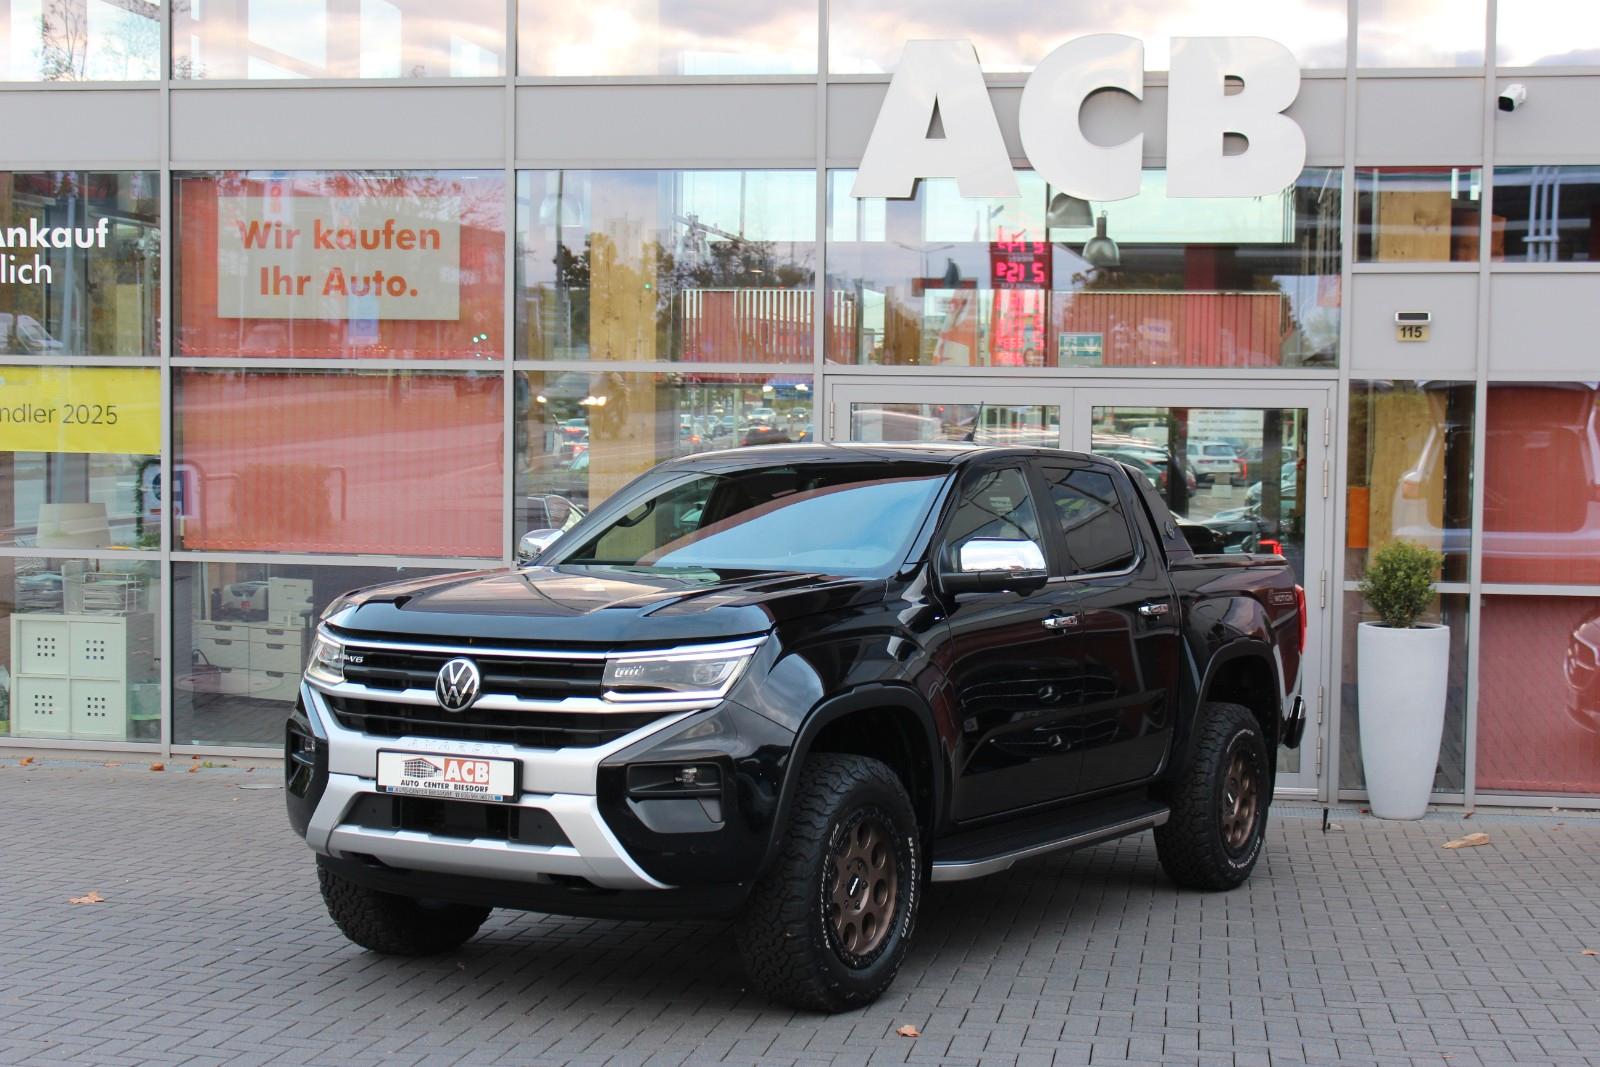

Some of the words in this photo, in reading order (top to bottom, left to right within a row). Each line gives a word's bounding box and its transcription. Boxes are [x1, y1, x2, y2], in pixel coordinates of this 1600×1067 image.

[850, 33, 1306, 202] ACB
[237, 220, 300, 249] Wir
[313, 219, 440, 250] kaufen
[260, 265, 311, 296] Ihr
[322, 266, 418, 297] Auto.
[1400, 326, 1422, 338] 115
[63, 404, 118, 425] 2025
[349, 655, 363, 664] V6
[445, 760, 489, 784] ACB
[400, 779, 419, 788] AUTO
[423, 781, 450, 790] CENTER
[453, 783, 489, 793] BIESDORF
